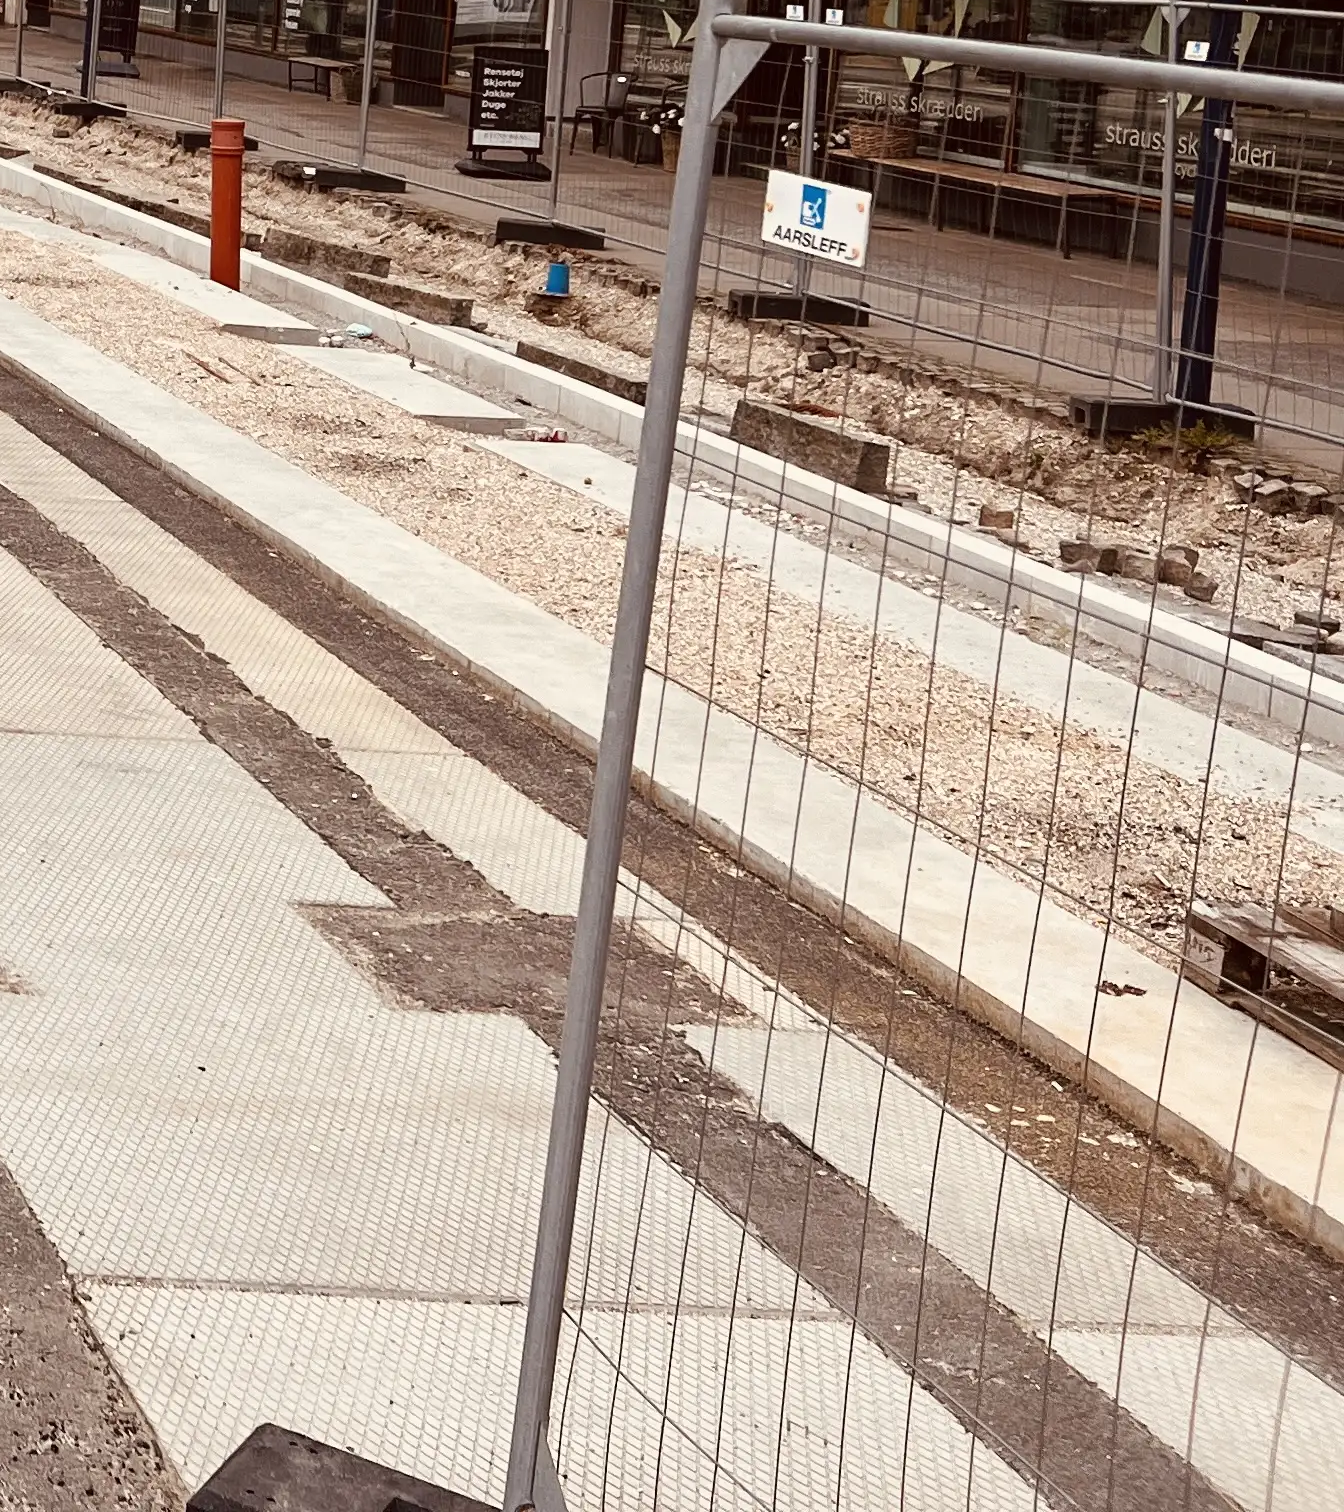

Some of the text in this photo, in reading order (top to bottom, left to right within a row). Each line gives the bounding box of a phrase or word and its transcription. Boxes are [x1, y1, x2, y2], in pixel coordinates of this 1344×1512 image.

[483, 78, 522, 88] Skjorter
[482, 89, 515, 98] Jakker
[856, 88, 906, 110] strauss
[481, 99, 507, 111] Duge
[480, 111, 500, 120] etc.
[773, 225, 848, 256] AARSLEFF
